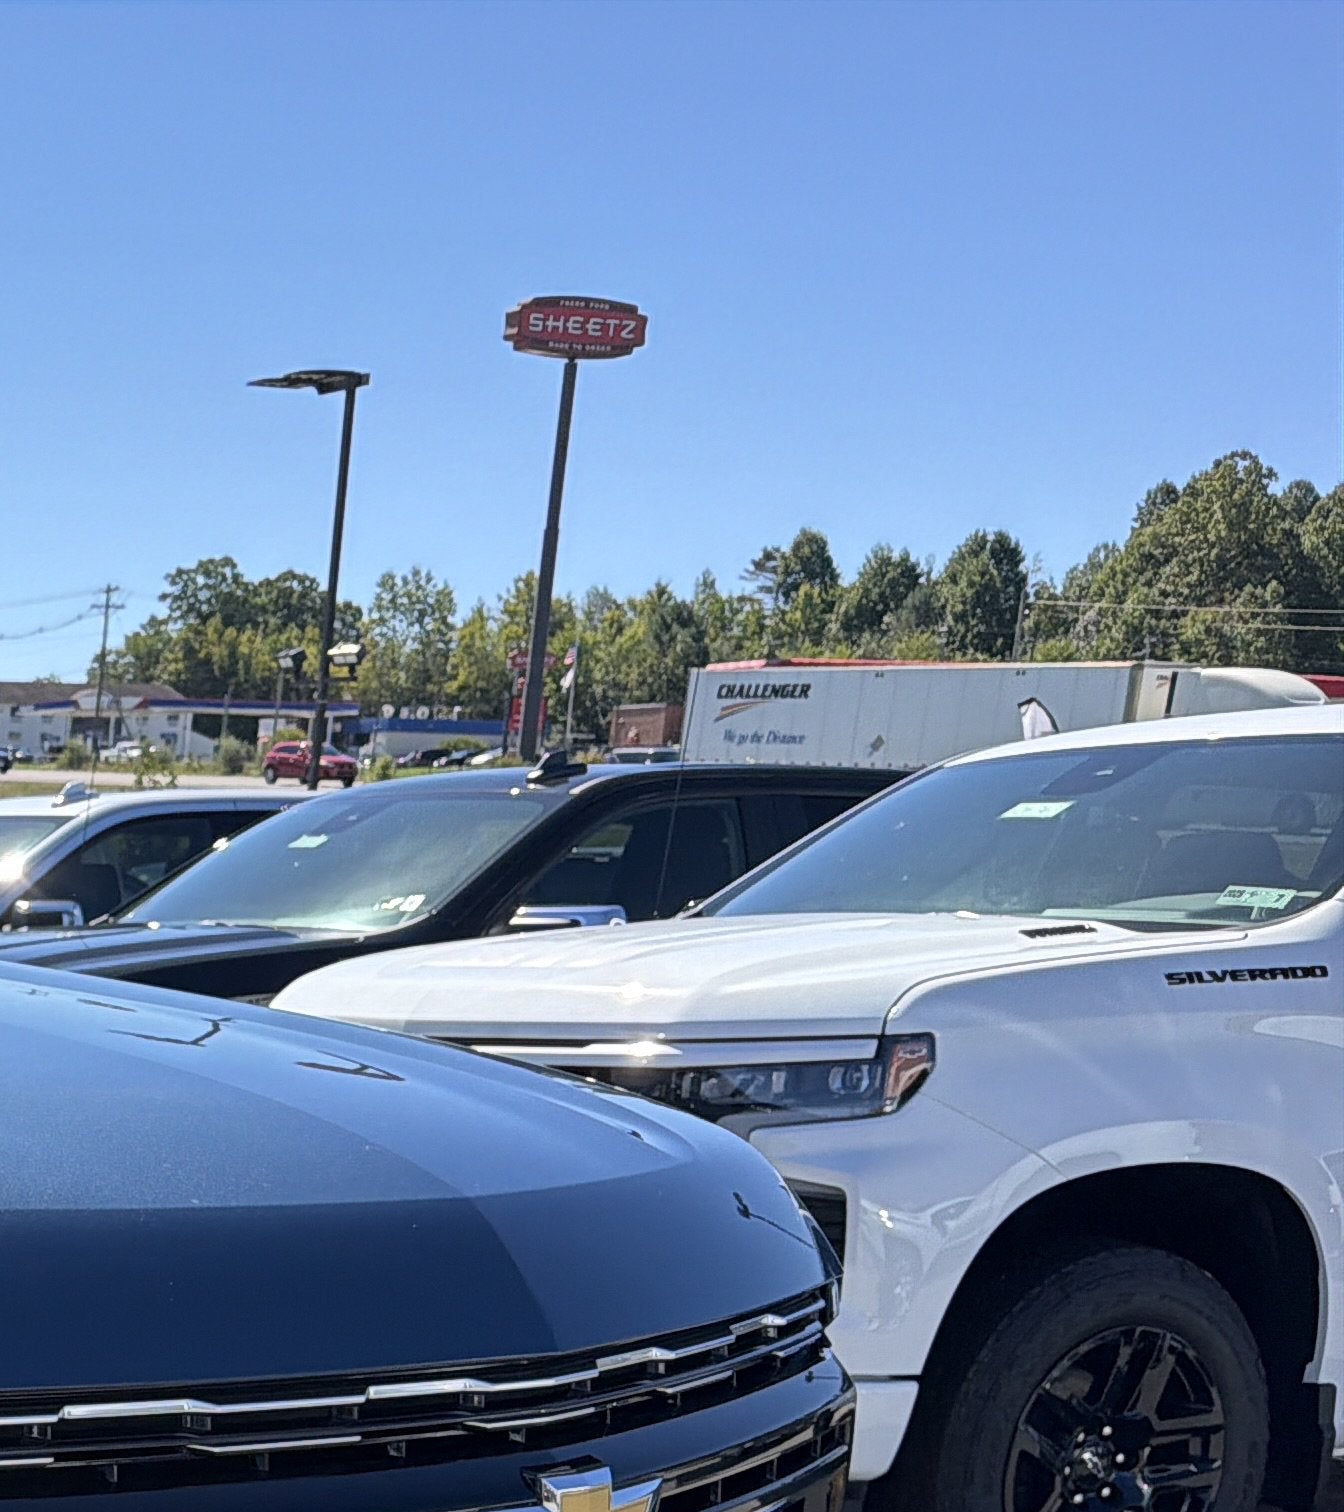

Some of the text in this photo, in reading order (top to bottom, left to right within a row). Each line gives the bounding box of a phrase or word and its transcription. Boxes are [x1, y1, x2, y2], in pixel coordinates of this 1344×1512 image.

[528, 312, 637, 340] SHEETZ
[716, 683, 812, 700] CHALLENGER
[1164, 965, 1329, 986] SILVERADO
